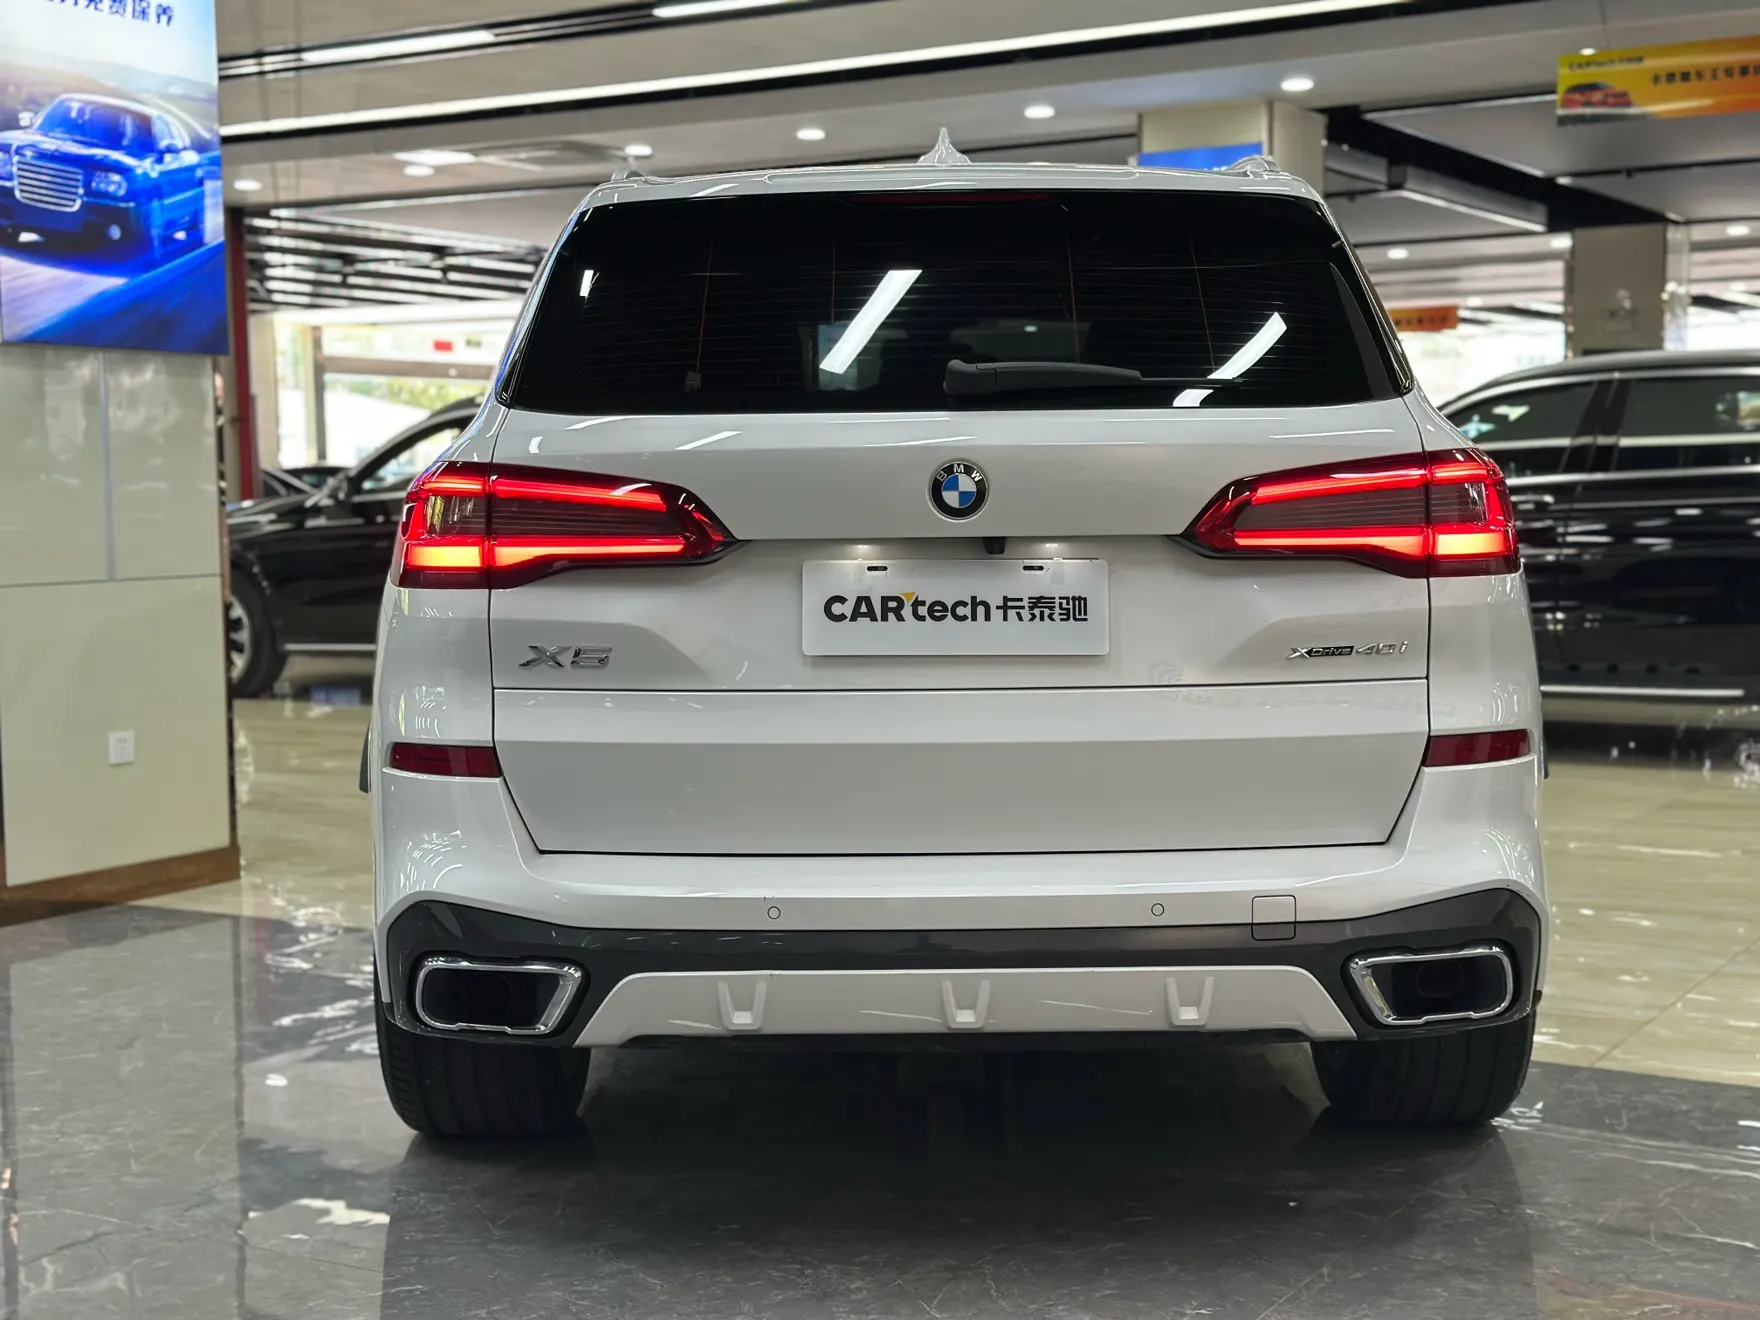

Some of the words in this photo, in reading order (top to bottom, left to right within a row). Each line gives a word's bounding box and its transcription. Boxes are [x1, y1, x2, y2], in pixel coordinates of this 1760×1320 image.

[936, 464, 982, 481] BMW
[996, 595, 1088, 622] 卡泰驰
[519, 645, 612, 668] X5
